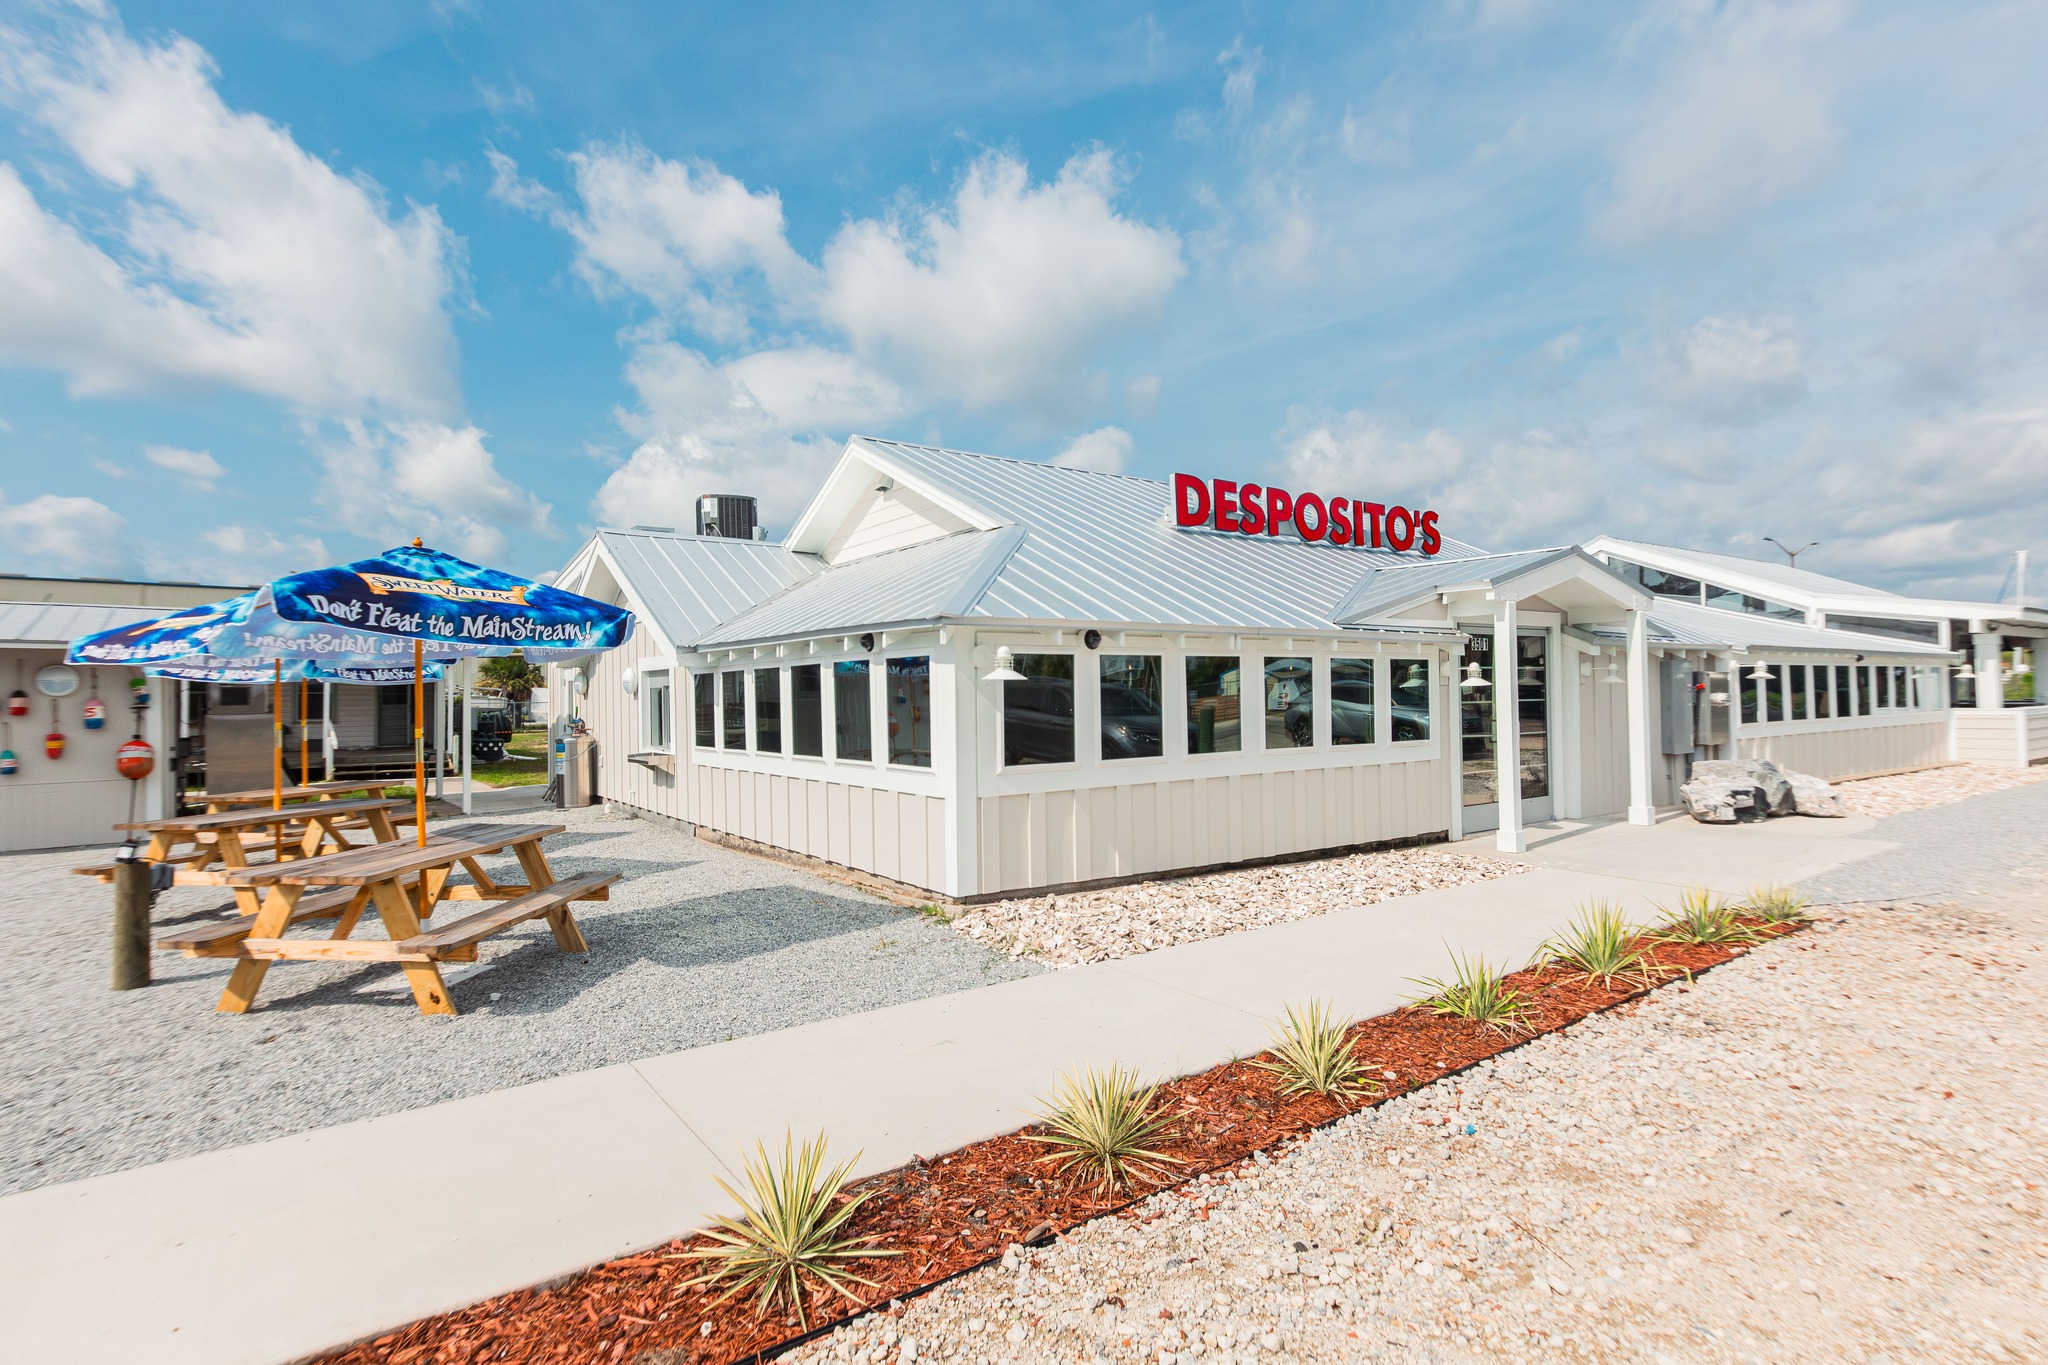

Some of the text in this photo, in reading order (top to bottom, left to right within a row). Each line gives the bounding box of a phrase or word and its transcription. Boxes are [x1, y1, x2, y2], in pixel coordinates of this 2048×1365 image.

[1172, 473, 1442, 555] DESPOSITO'S
[307, 595, 592, 641] Don't Float the MainStream!
[1471, 637, 1489, 651] 3501
